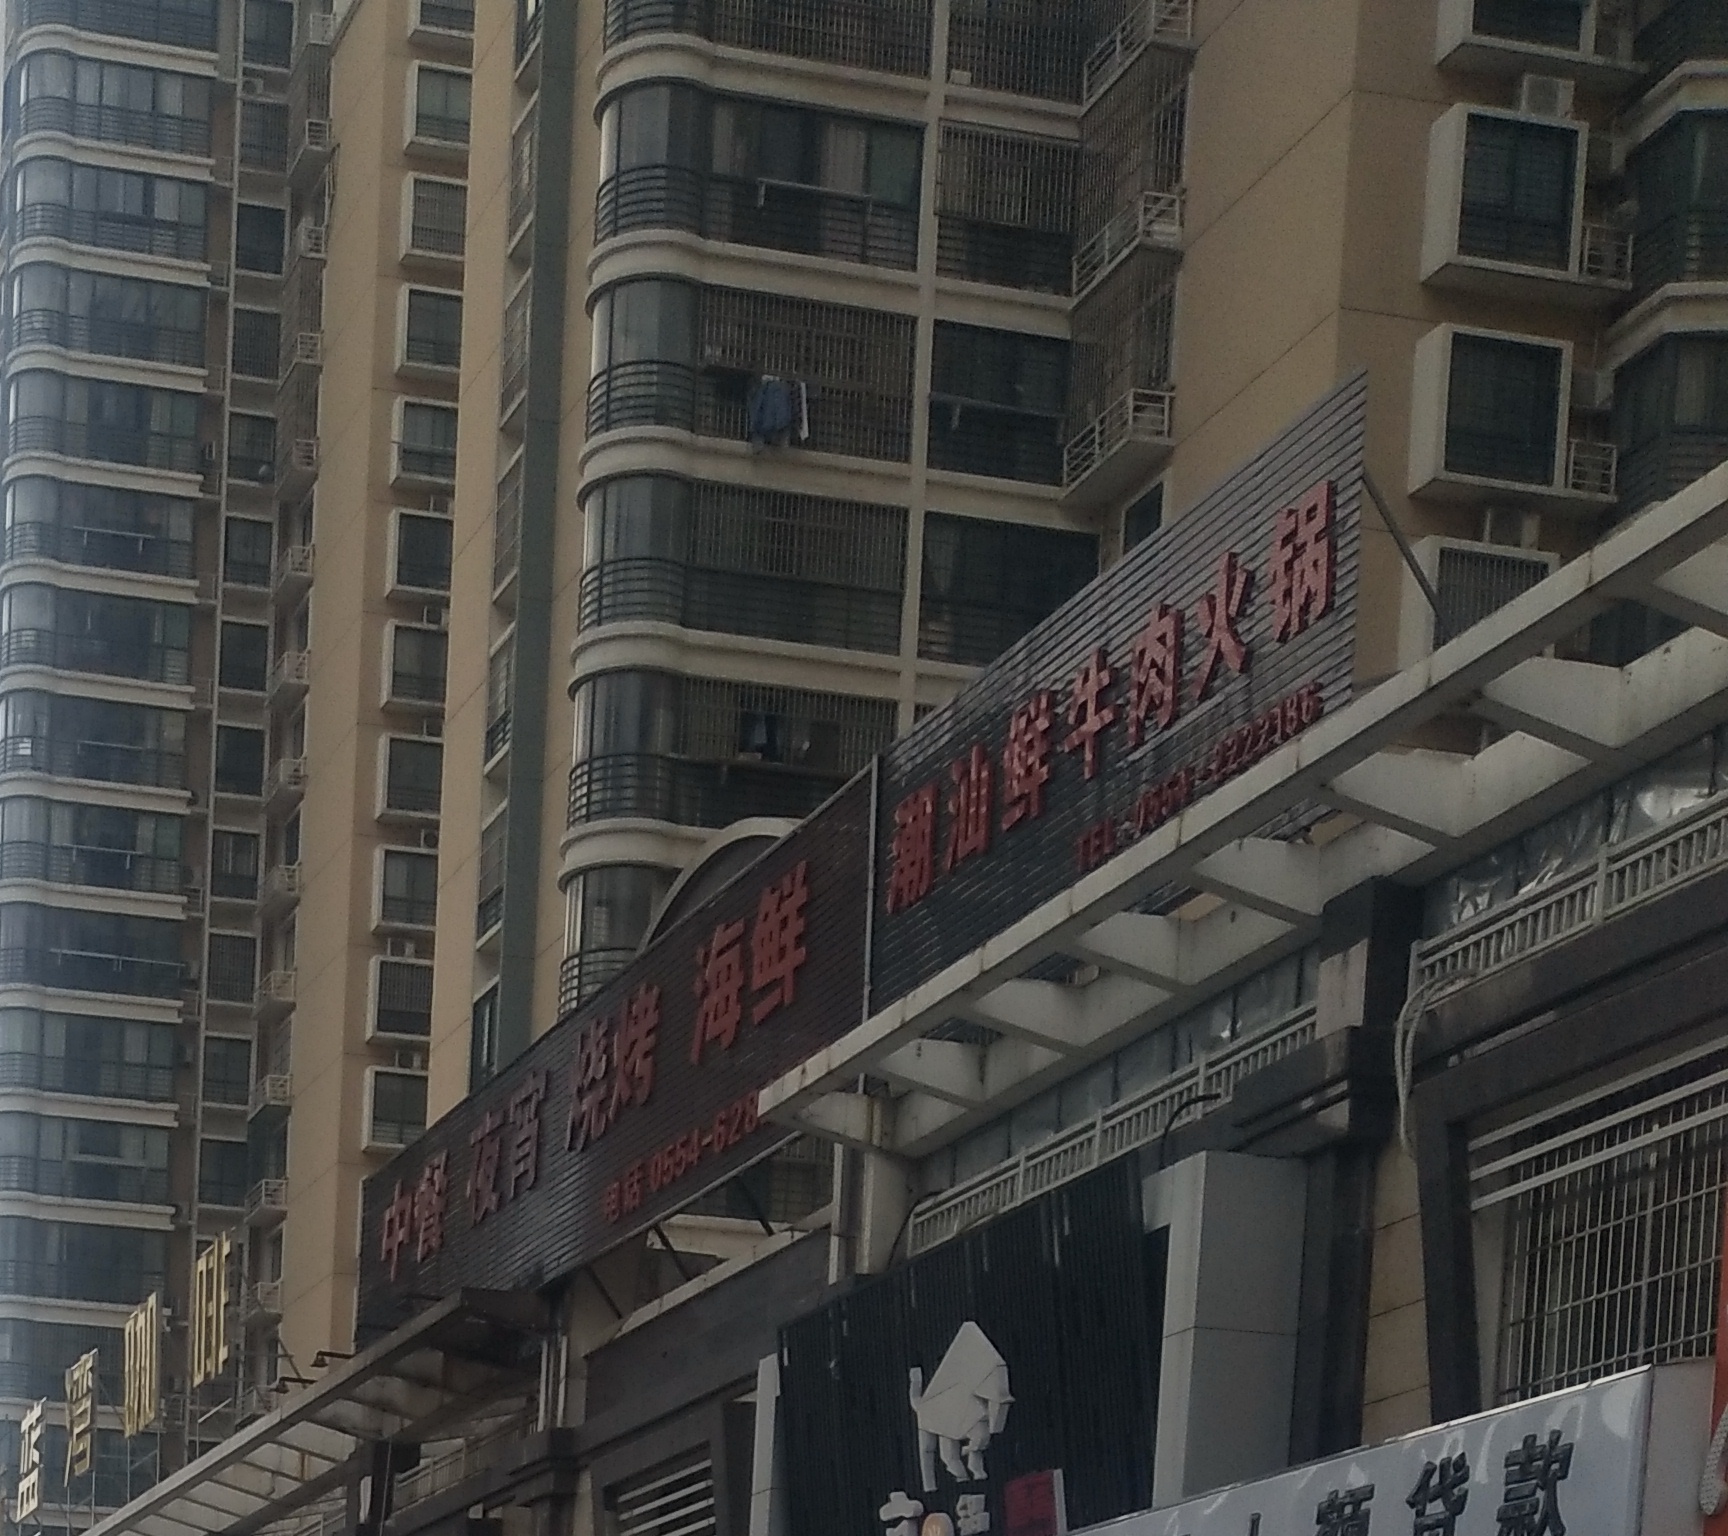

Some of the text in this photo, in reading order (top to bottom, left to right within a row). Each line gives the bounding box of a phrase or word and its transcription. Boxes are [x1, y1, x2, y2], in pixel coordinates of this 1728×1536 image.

[886, 479, 1334, 915] 潮汕鲜牛肉火锅
[381, 860, 809, 1283] 中餐 夜宵 烧烤 海鲜
